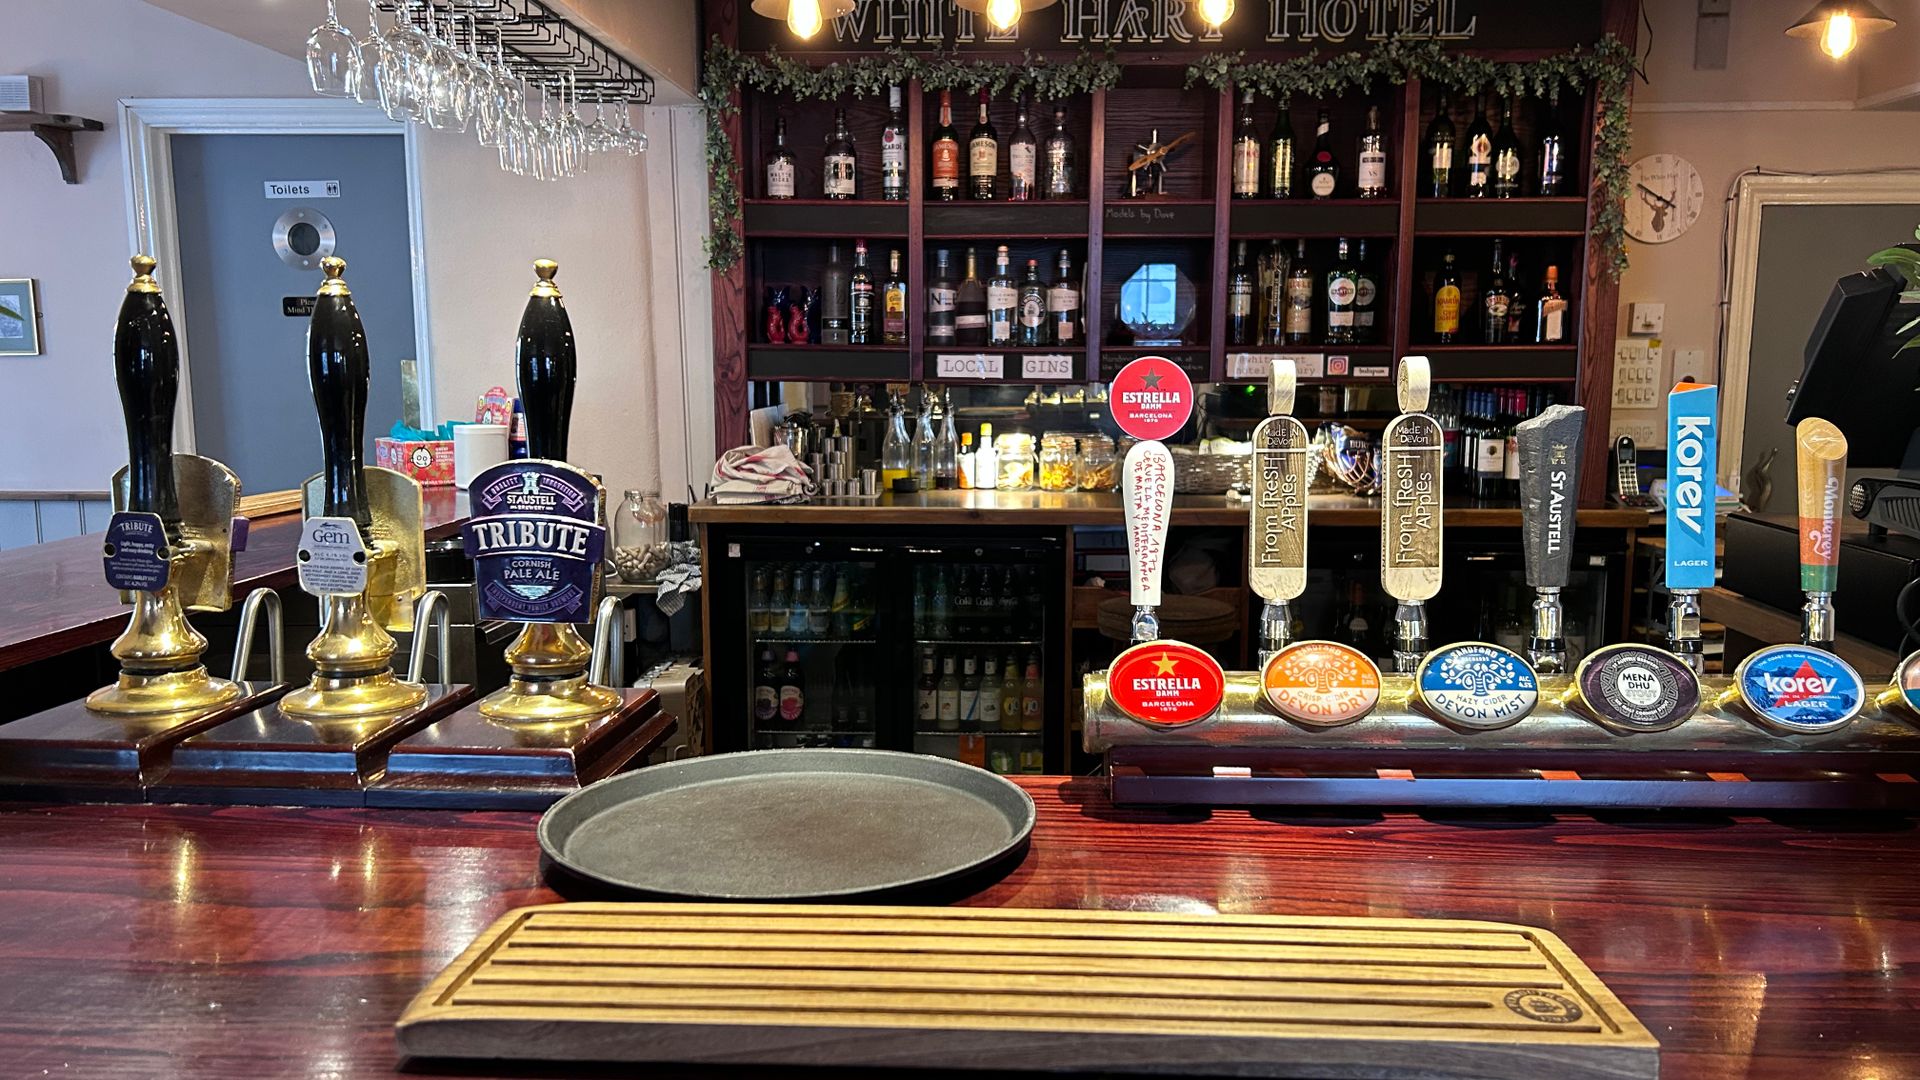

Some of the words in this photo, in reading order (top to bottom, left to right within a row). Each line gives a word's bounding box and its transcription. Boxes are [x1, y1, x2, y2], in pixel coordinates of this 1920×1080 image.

[1266, 0, 1477, 42] HOTEL
[270, 185, 310, 194] Toilets
[1105, 208, 1135, 218] Models
[1140, 208, 1151, 224] by
[287, 306, 306, 314] Mind
[944, 360, 998, 372] LOCAL
[1025, 360, 1069, 373] GINS
[1122, 391, 1181, 403] ESTRELLA
[1134, 461, 1142, 472] DE
[1143, 450, 1153, 502] CERVEZA
[1676, 416, 1711, 535] korev
[490, 477, 519, 494] QUALITY
[1133, 475, 1143, 510] MALTA
[1809, 476, 1839, 560] Monterey
[120, 522, 154, 533] TRIBUTE
[312, 529, 350, 544] Gem
[472, 520, 590, 555] TRIBUTE
[1133, 525, 1141, 555] ARROZ
[1261, 515, 1283, 564] From
[1395, 514, 1419, 563] From
[1139, 506, 1151, 592] MEDITERRANEA
[511, 560, 551, 569] CORNISH
[504, 569, 532, 579] PALE
[535, 569, 560, 581] ALE
[1450, 646, 1498, 658] SANDFORD
[1133, 678, 1201, 690] ESTRELLA
[1622, 673, 1655, 682] MENA
[1764, 672, 1838, 693] korev
[1628, 681, 1650, 689] DHU
[1297, 690, 1322, 702] CRISP
[1325, 690, 1350, 702] CIDER
[1456, 694, 1478, 705] HAZY
[1483, 694, 1508, 705] CIDER
[1625, 689, 1658, 697] STOUT
[1278, 689, 1332, 715] DEVON
[1338, 689, 1368, 714] DRY
[1435, 693, 1487, 718] DEVON
[1494, 693, 1526, 718] MIST
[1784, 700, 1828, 708] LAGER
